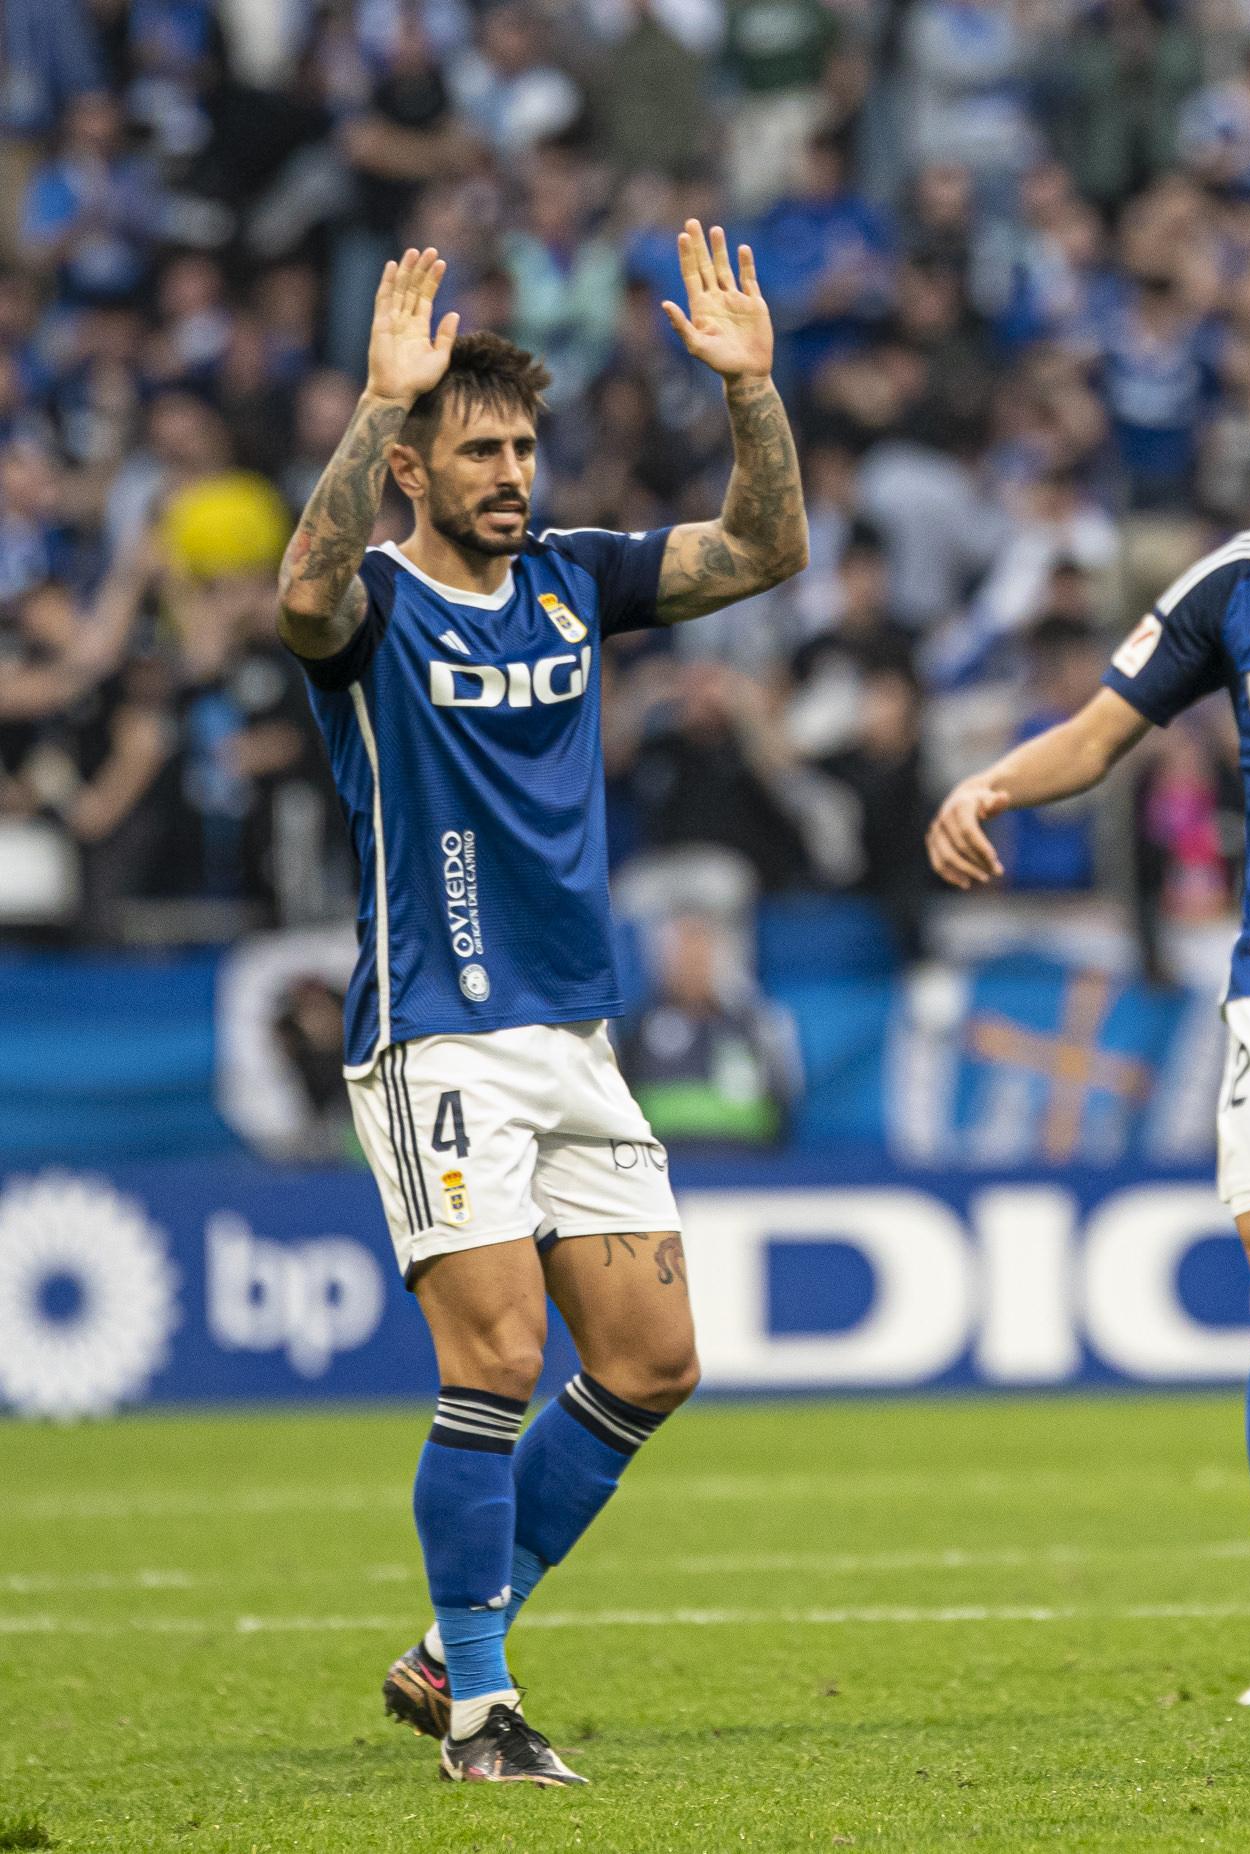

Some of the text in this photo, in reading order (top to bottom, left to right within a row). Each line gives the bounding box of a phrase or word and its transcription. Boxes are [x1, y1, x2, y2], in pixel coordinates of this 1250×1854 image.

[429, 645, 591, 708] DIGI
[463, 830, 477, 882] CAMINO
[441, 830, 475, 958] OVIEDO
[431, 1090, 471, 1159] 4
[206, 1210, 385, 1379] bp
